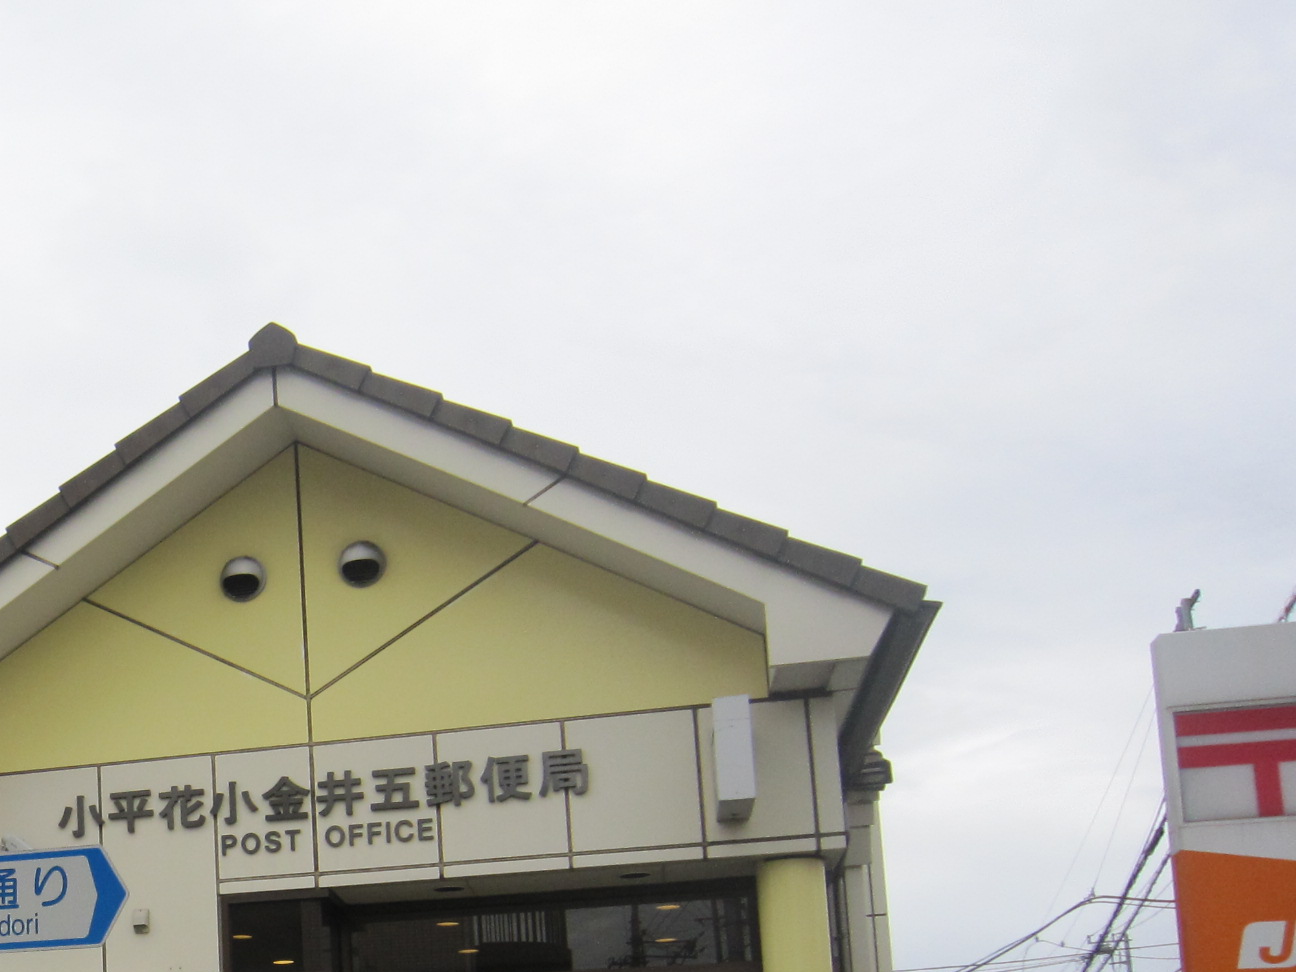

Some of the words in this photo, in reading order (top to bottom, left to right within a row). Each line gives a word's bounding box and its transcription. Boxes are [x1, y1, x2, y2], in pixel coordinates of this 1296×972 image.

[58, 748, 589, 838] 小平花小金井五郵便局
[220, 829, 301, 856] POST
[324, 818, 435, 848] OFFICE
[1237, 921, 1296, 970] J
